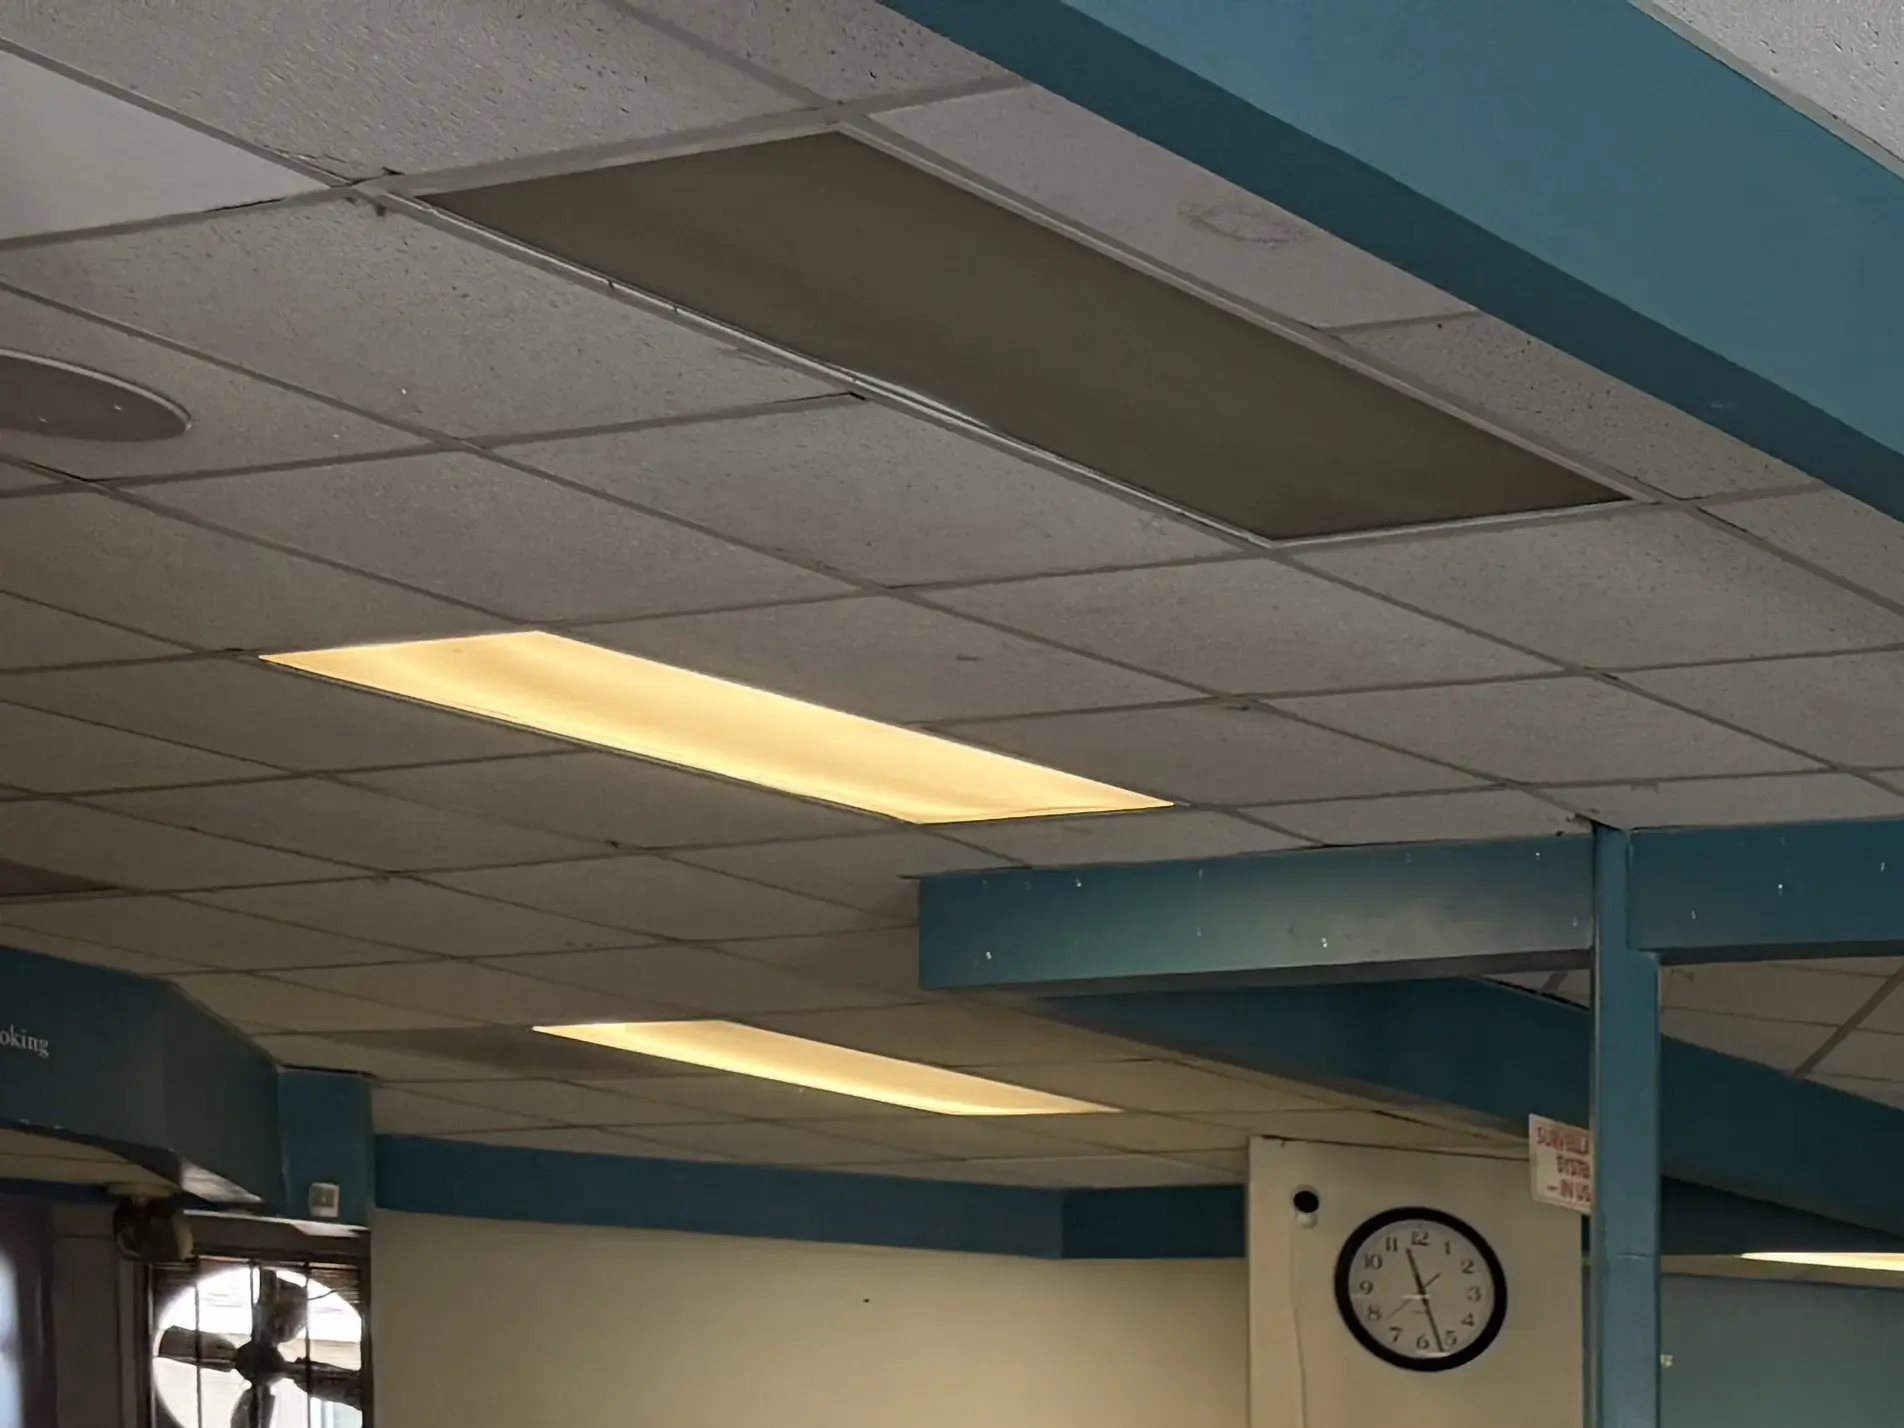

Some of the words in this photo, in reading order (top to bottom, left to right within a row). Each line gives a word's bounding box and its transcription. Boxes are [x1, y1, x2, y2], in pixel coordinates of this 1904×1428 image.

[1385, 1236, 1398, 1252] 11
[1410, 1231, 1430, 1247] 12
[1443, 1241, 1451, 1256] 1
[1363, 1254, 1383, 1271] 10
[1460, 1258, 1475, 1275] 2
[1359, 1280, 1374, 1296] 9
[1467, 1286, 1482, 1302] 3
[1365, 1304, 1382, 1322] 8
[1460, 1312, 1476, 1328] 4
[1389, 1327, 1403, 1343] 7
[1415, 1333, 1431, 1350] 6
[1444, 1330, 1458, 1347] 5
